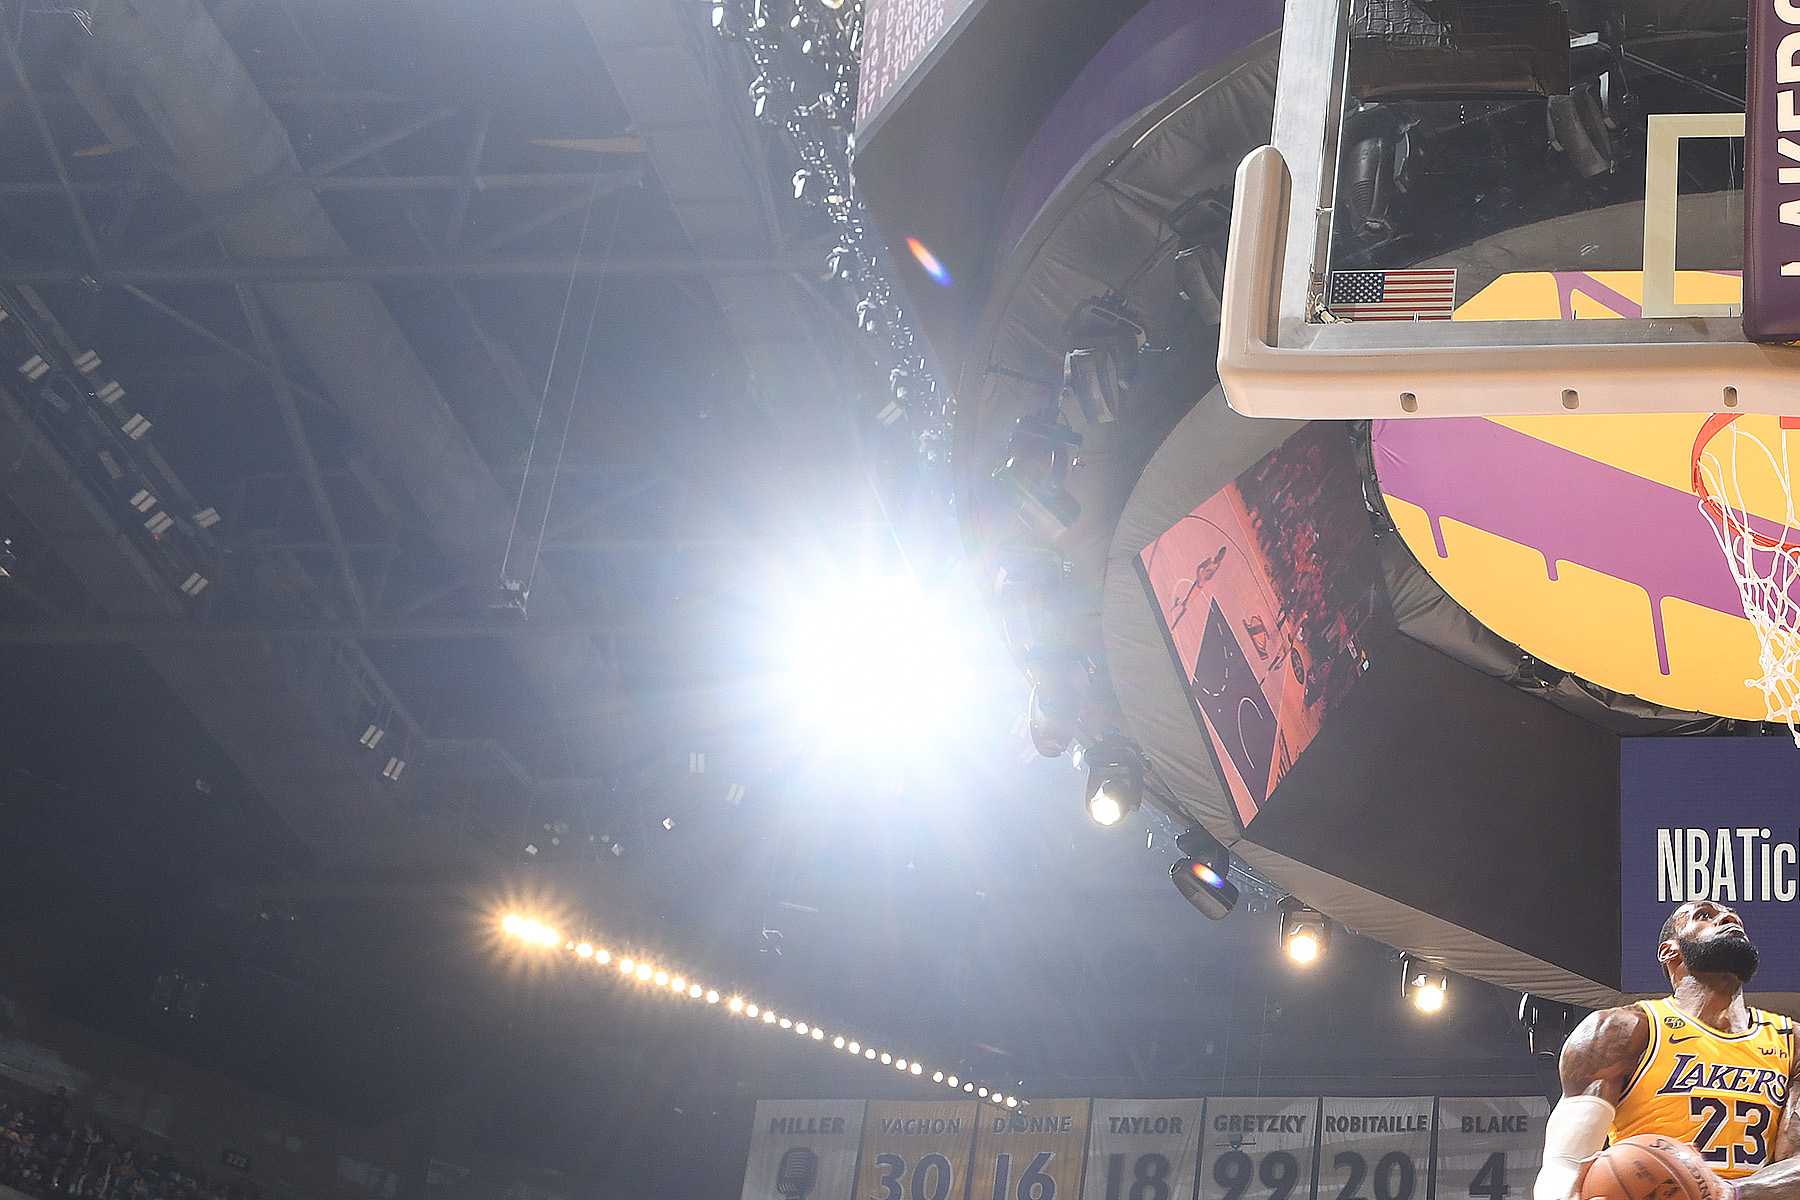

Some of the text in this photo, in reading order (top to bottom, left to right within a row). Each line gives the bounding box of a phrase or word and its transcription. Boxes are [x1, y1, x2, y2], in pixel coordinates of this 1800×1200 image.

[1655, 1053, 1789, 1107] LAKERS
[770, 1116, 846, 1136] MILLER
[881, 1116, 962, 1136] VACHON
[1108, 1115, 1183, 1135] TAYLOR
[1213, 1114, 1307, 1134] GRETZKY
[1325, 1114, 1428, 1133] ROBITAILLE
[1461, 1115, 1529, 1134] BLAKE
[1689, 1096, 1773, 1170] 23
